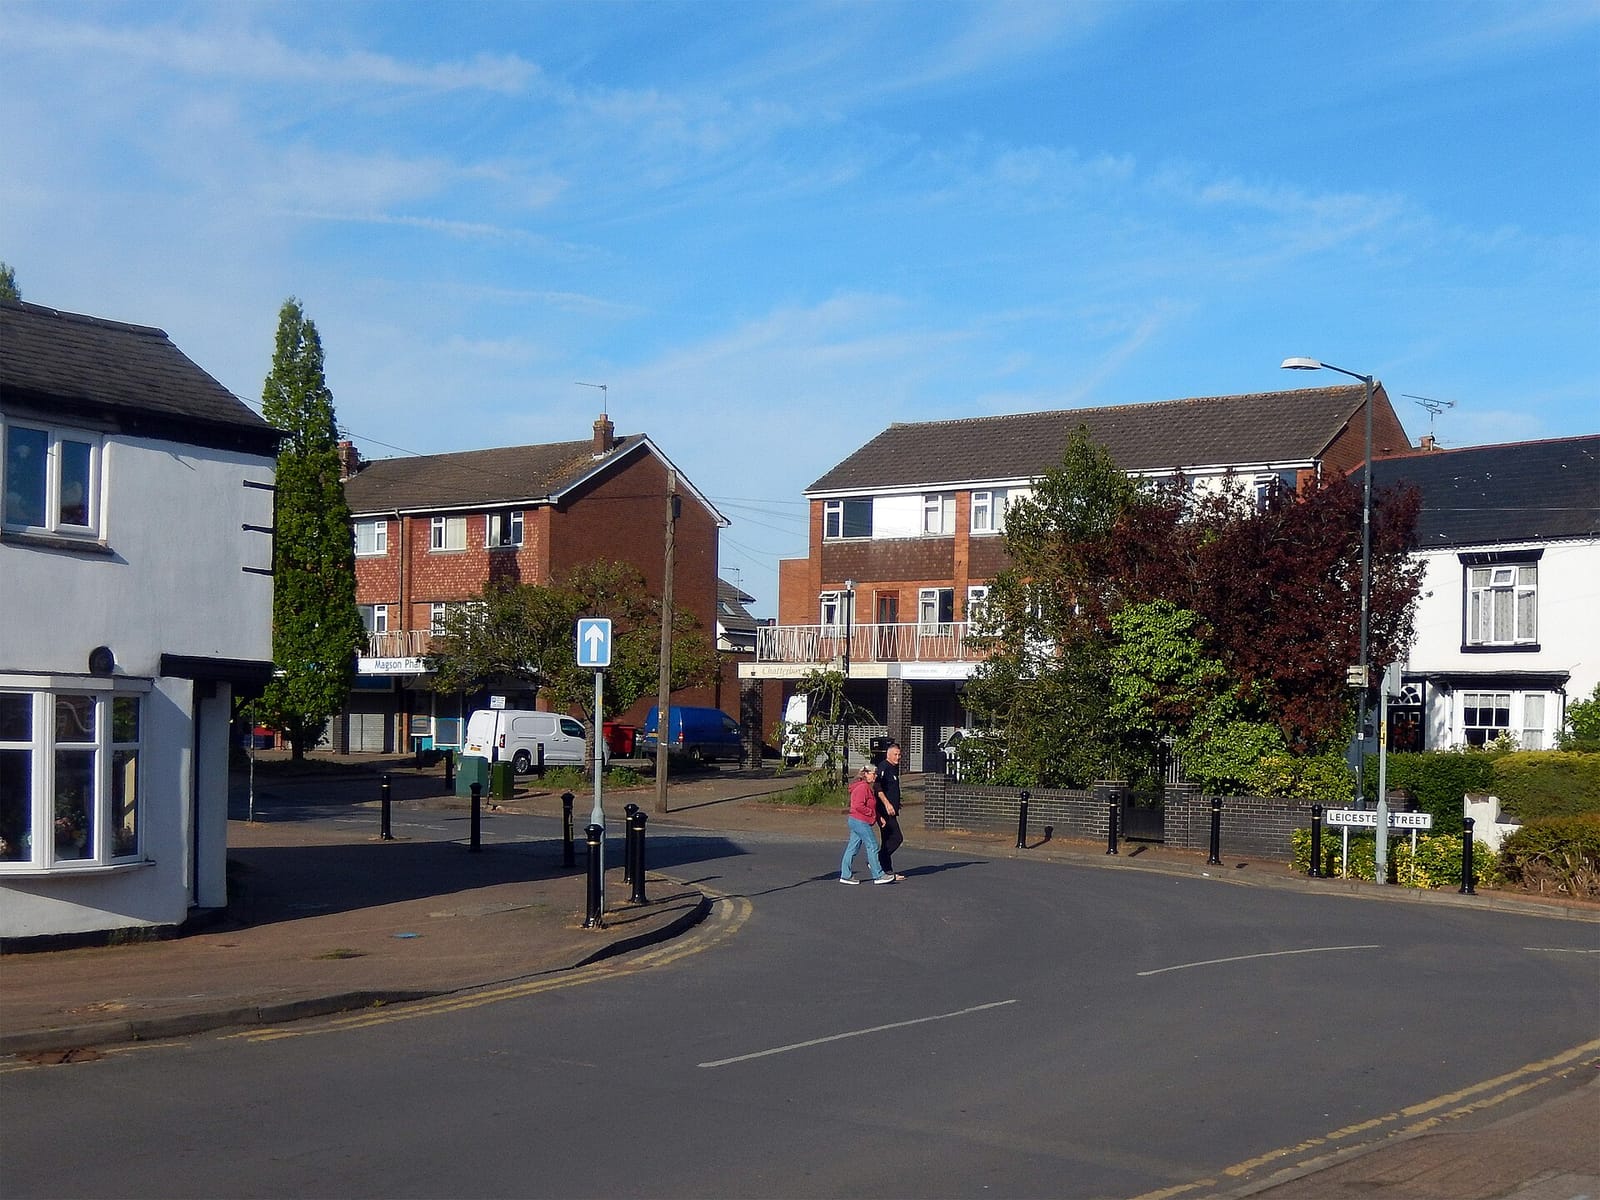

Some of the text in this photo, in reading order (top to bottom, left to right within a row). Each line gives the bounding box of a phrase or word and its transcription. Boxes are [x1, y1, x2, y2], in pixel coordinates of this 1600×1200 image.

[374, 660, 401, 671] Magson
[1329, 813, 1428, 825] LEICESTE STREET
